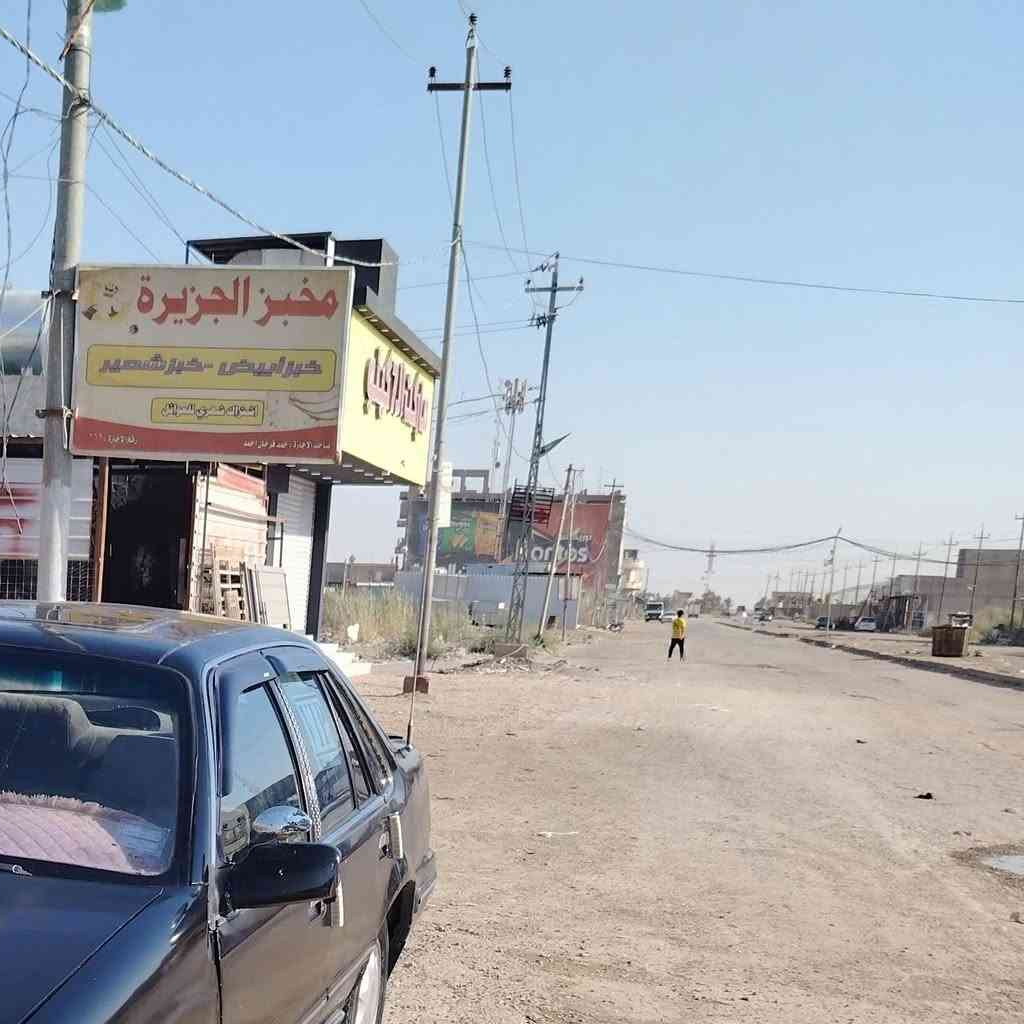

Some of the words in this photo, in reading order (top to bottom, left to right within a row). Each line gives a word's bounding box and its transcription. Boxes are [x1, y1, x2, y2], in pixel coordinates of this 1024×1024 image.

[136, 274, 251, 326] الجزيرة
[254, 276, 340, 327] مخبز
[99, 353, 165, 376] شعير
